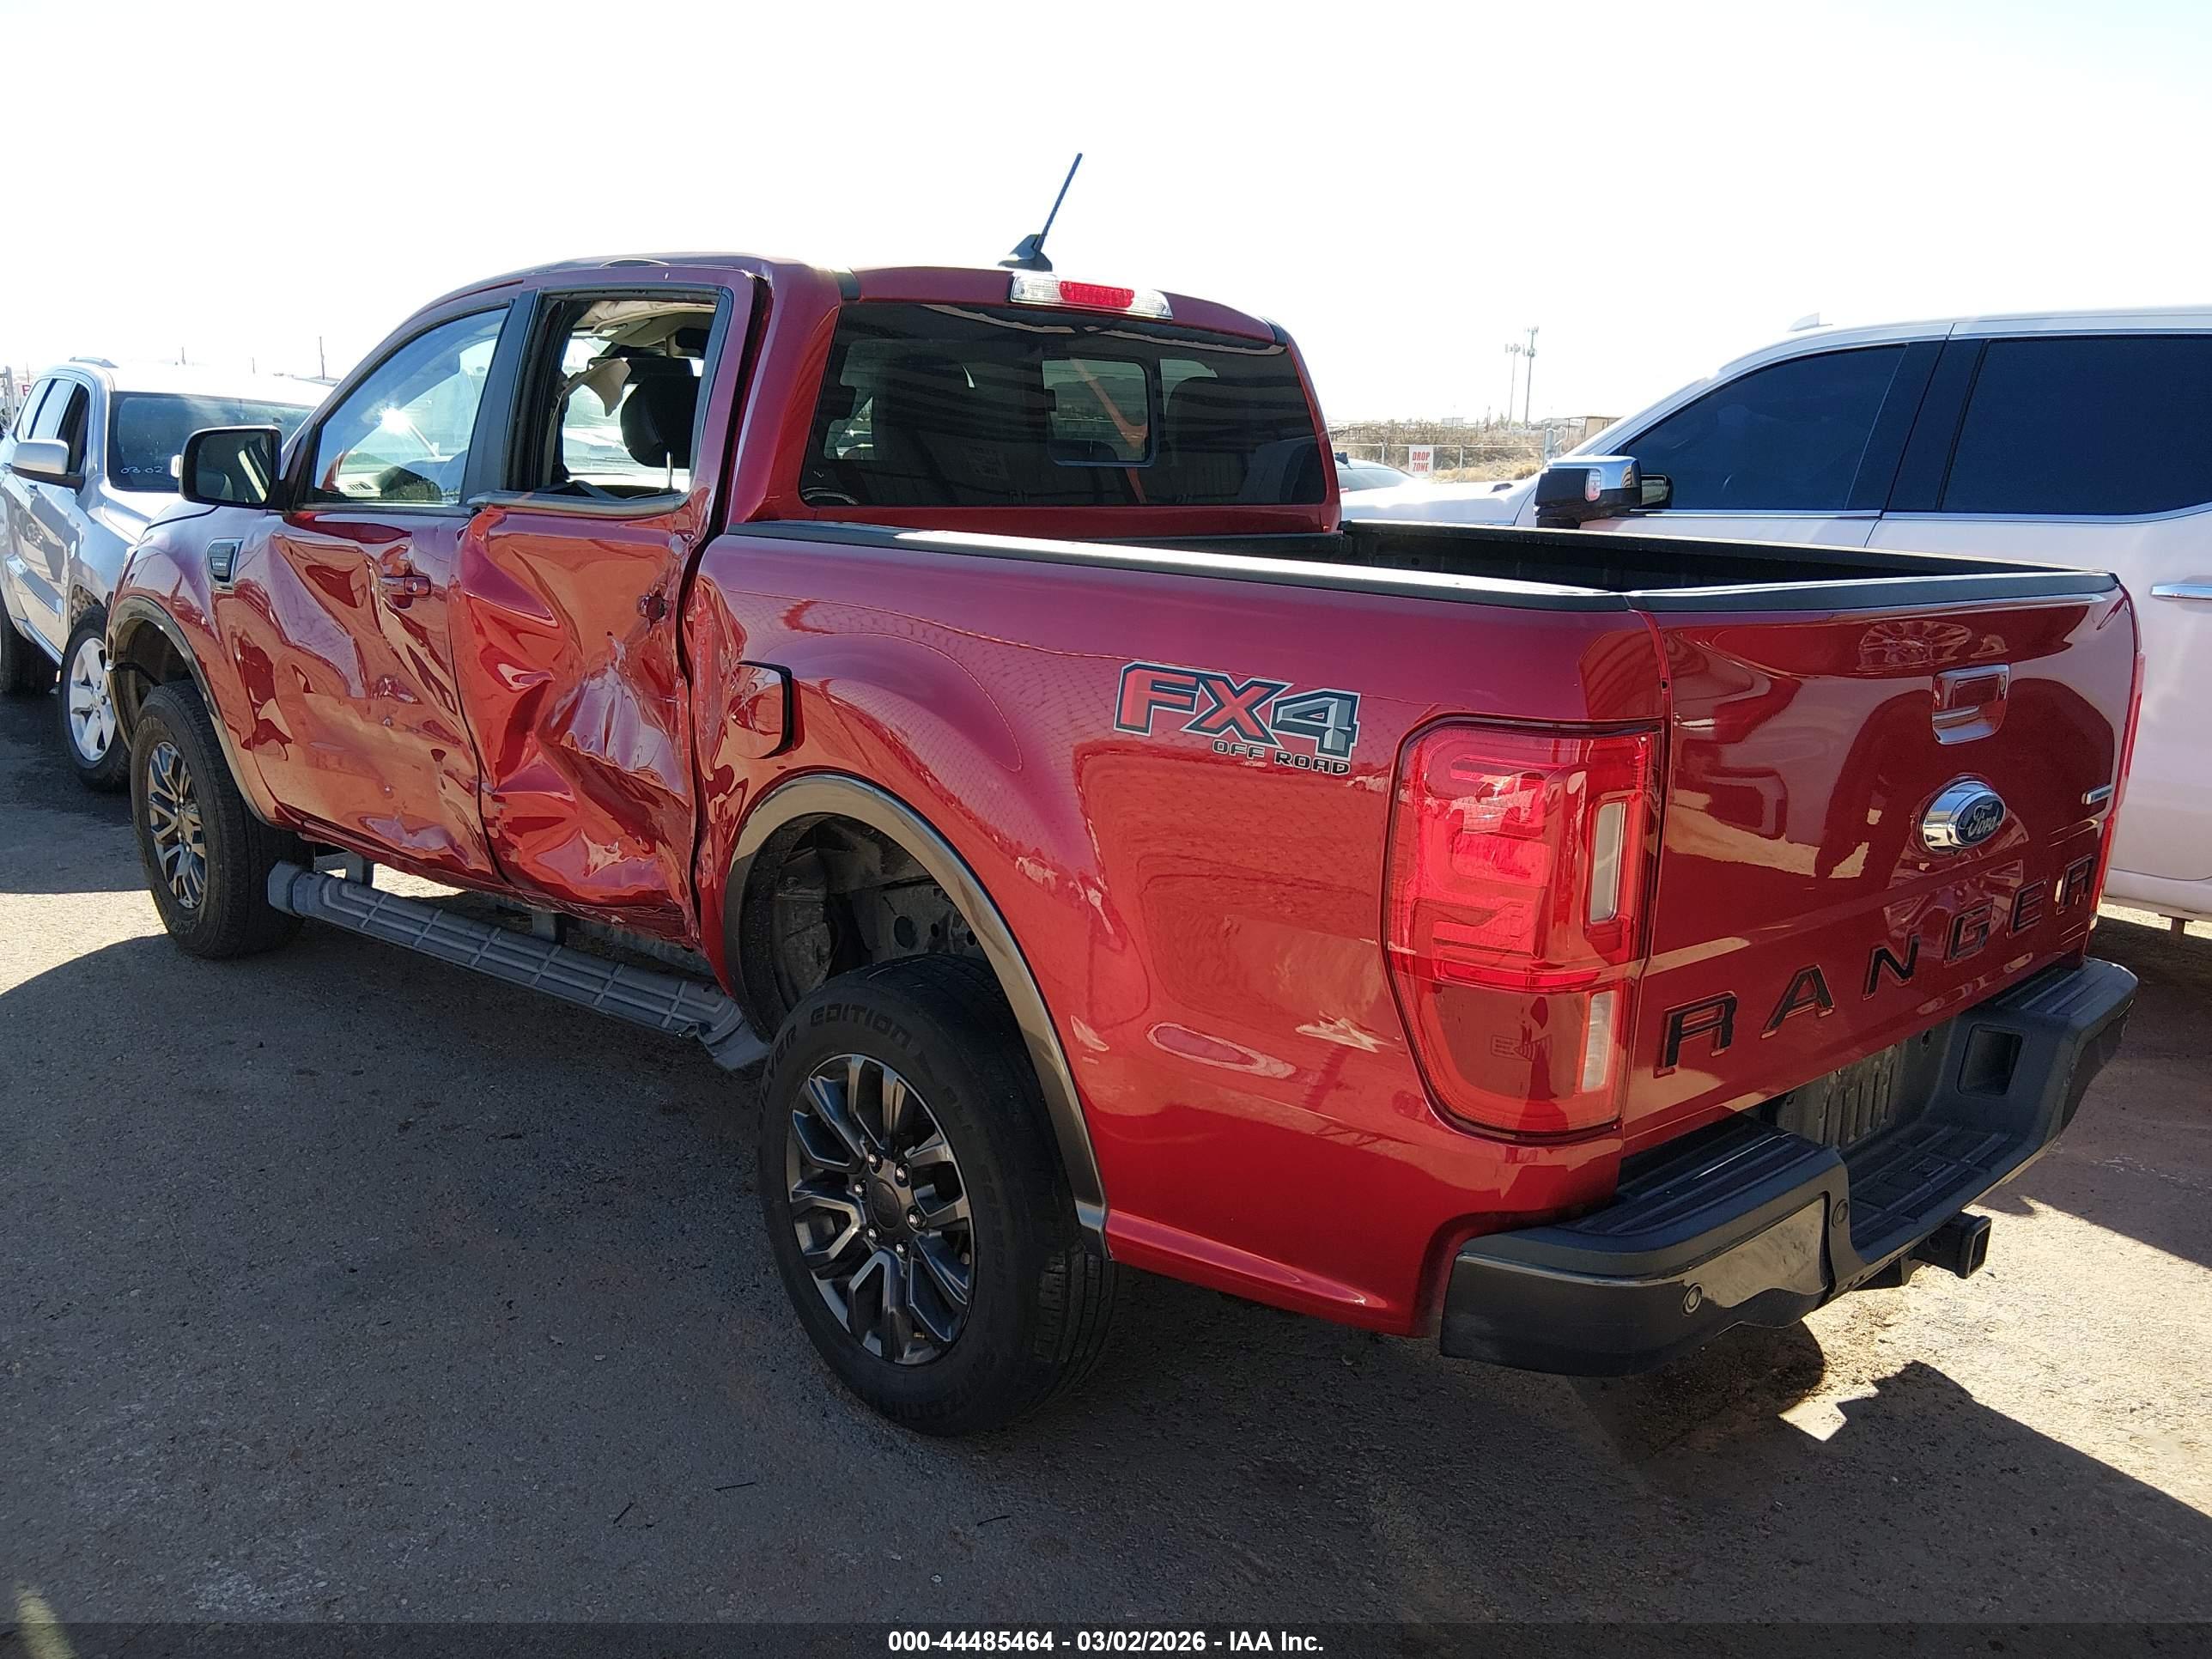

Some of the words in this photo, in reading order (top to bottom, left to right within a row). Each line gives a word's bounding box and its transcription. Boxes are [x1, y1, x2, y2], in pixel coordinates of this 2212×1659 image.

[1412, 451, 1431, 461] DROP
[1412, 462, 1430, 472] ZONE
[1114, 660, 1361, 761] FX4
[1212, 738, 1266, 760] OFF
[1273, 748, 1351, 776] ROAD
[1654, 854, 2095, 1079] RANGER
[810, 1002, 913, 1050] EDITION
